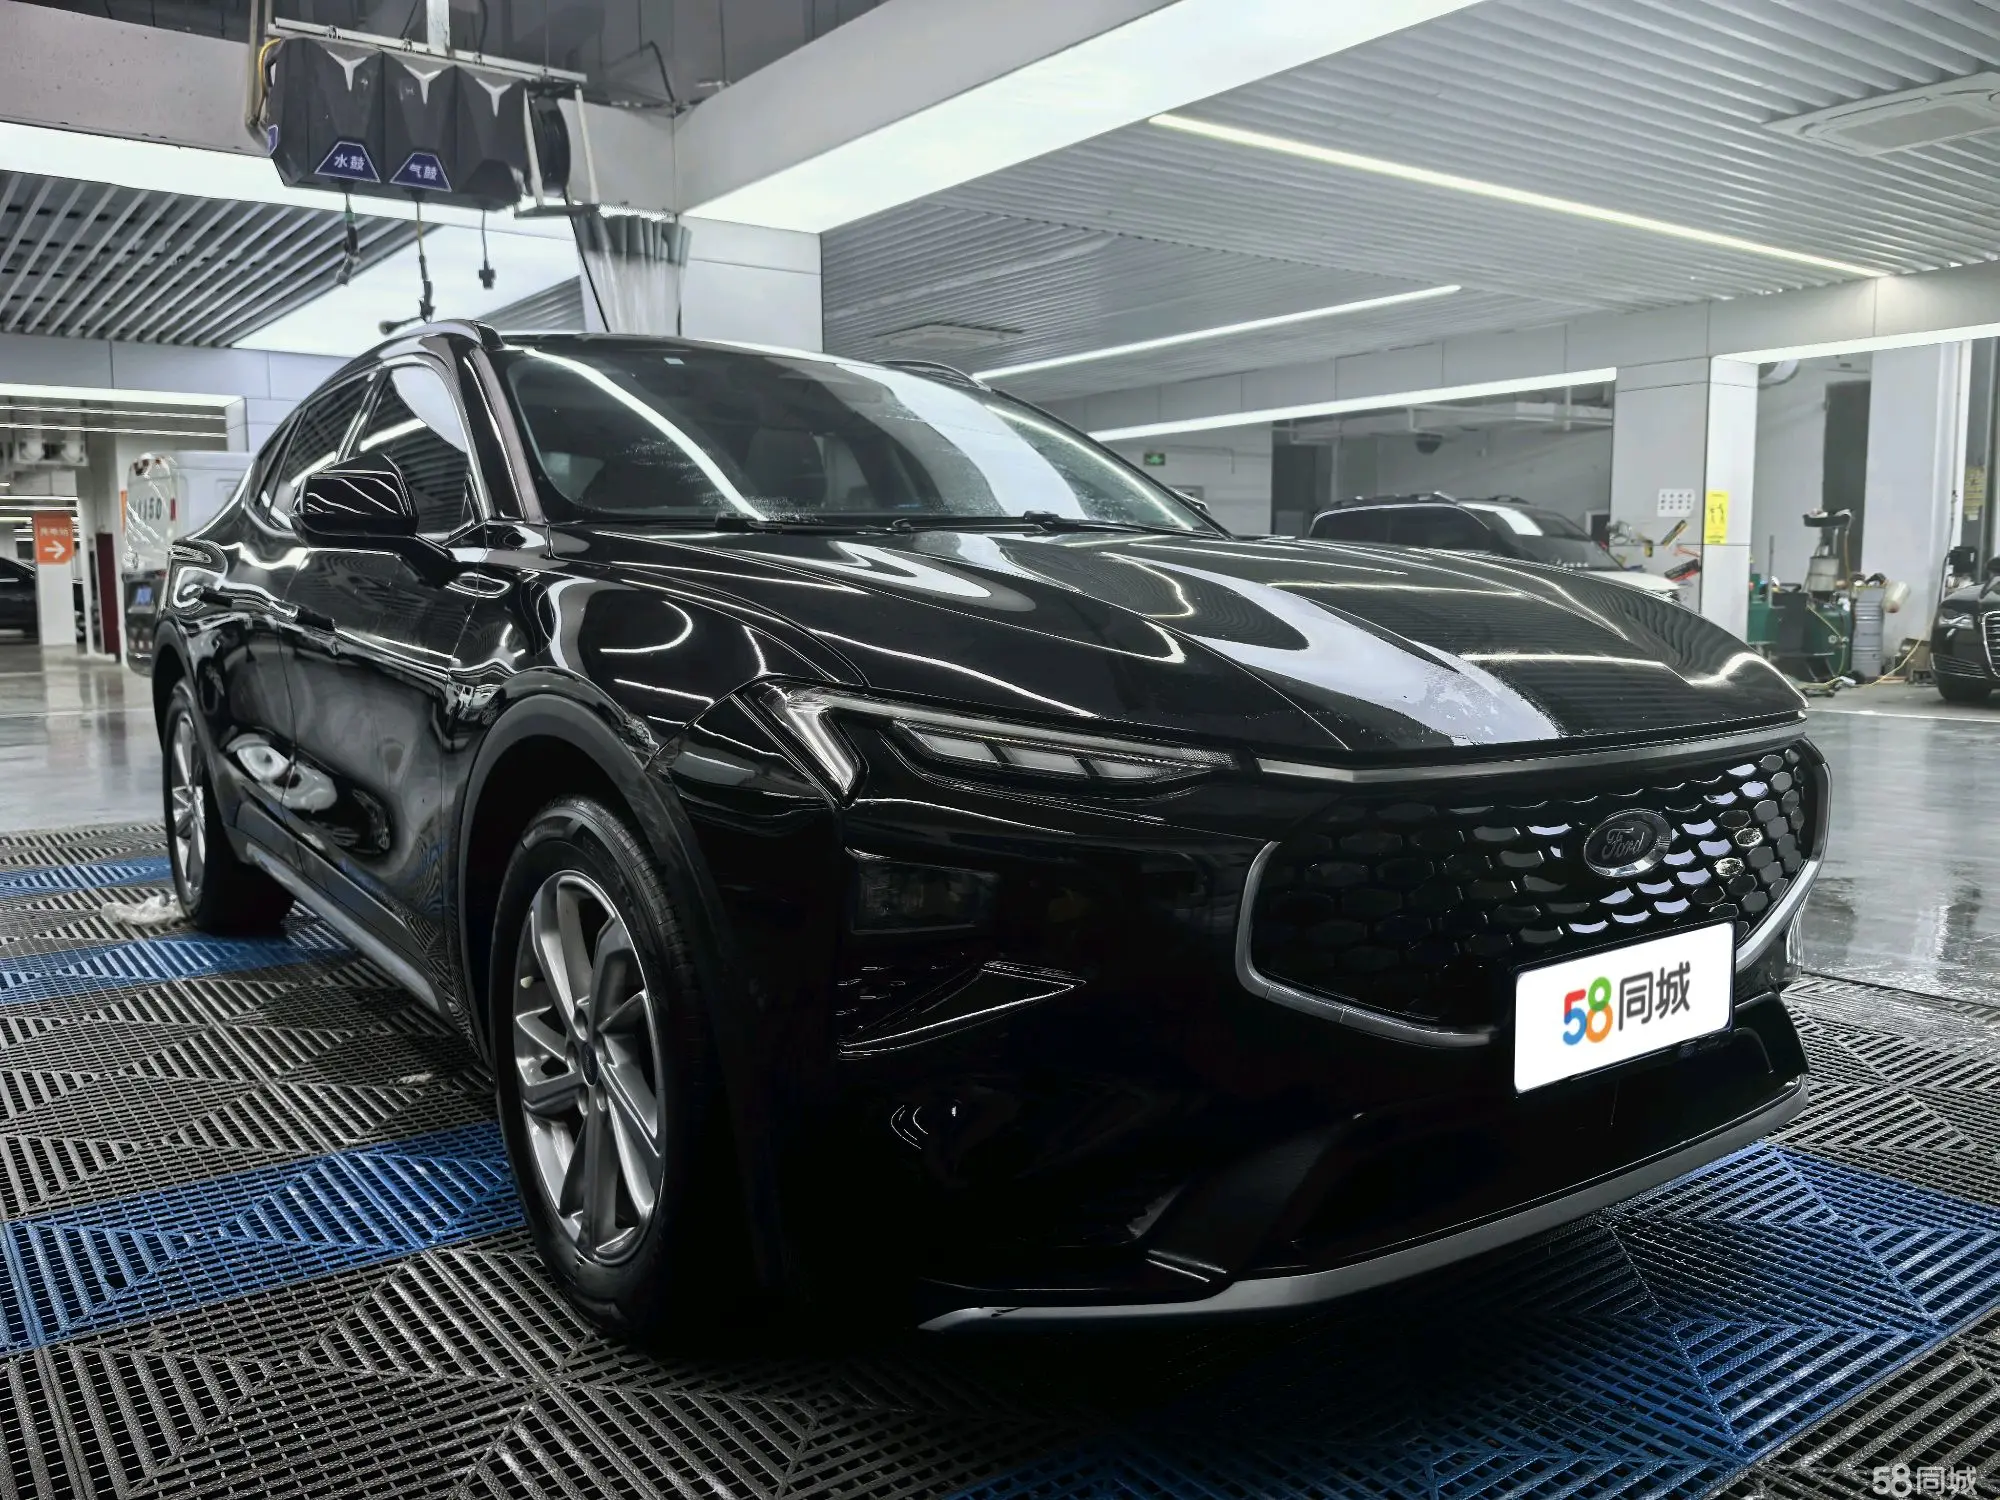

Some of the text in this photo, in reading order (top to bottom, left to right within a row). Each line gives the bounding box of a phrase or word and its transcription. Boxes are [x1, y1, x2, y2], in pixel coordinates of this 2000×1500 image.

[334, 153, 366, 172] 水鼓
[408, 163, 438, 181] 气鼓
[1601, 827, 1645, 860] Ford
